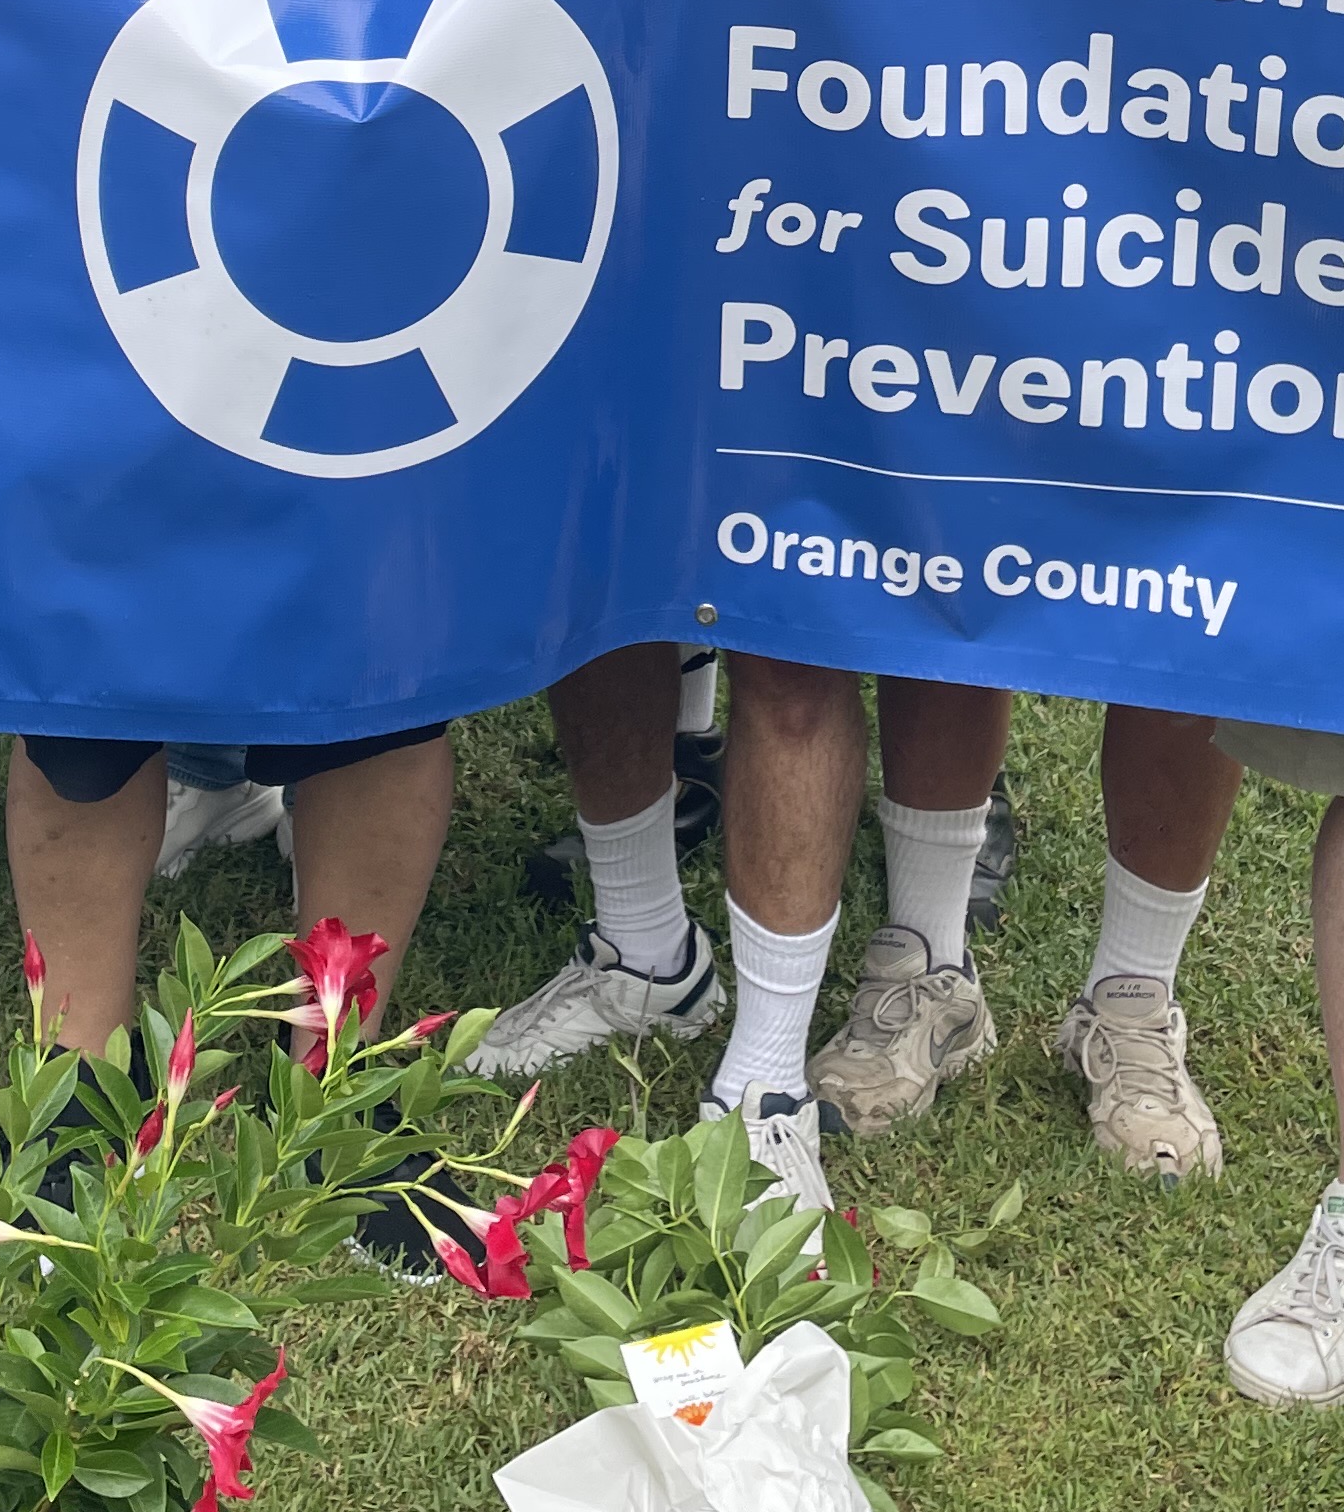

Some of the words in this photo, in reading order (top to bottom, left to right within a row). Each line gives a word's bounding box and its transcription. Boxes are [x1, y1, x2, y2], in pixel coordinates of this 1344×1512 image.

[716, 179, 862, 252] for
[718, 513, 963, 596] Orange
[984, 545, 1237, 636] County
